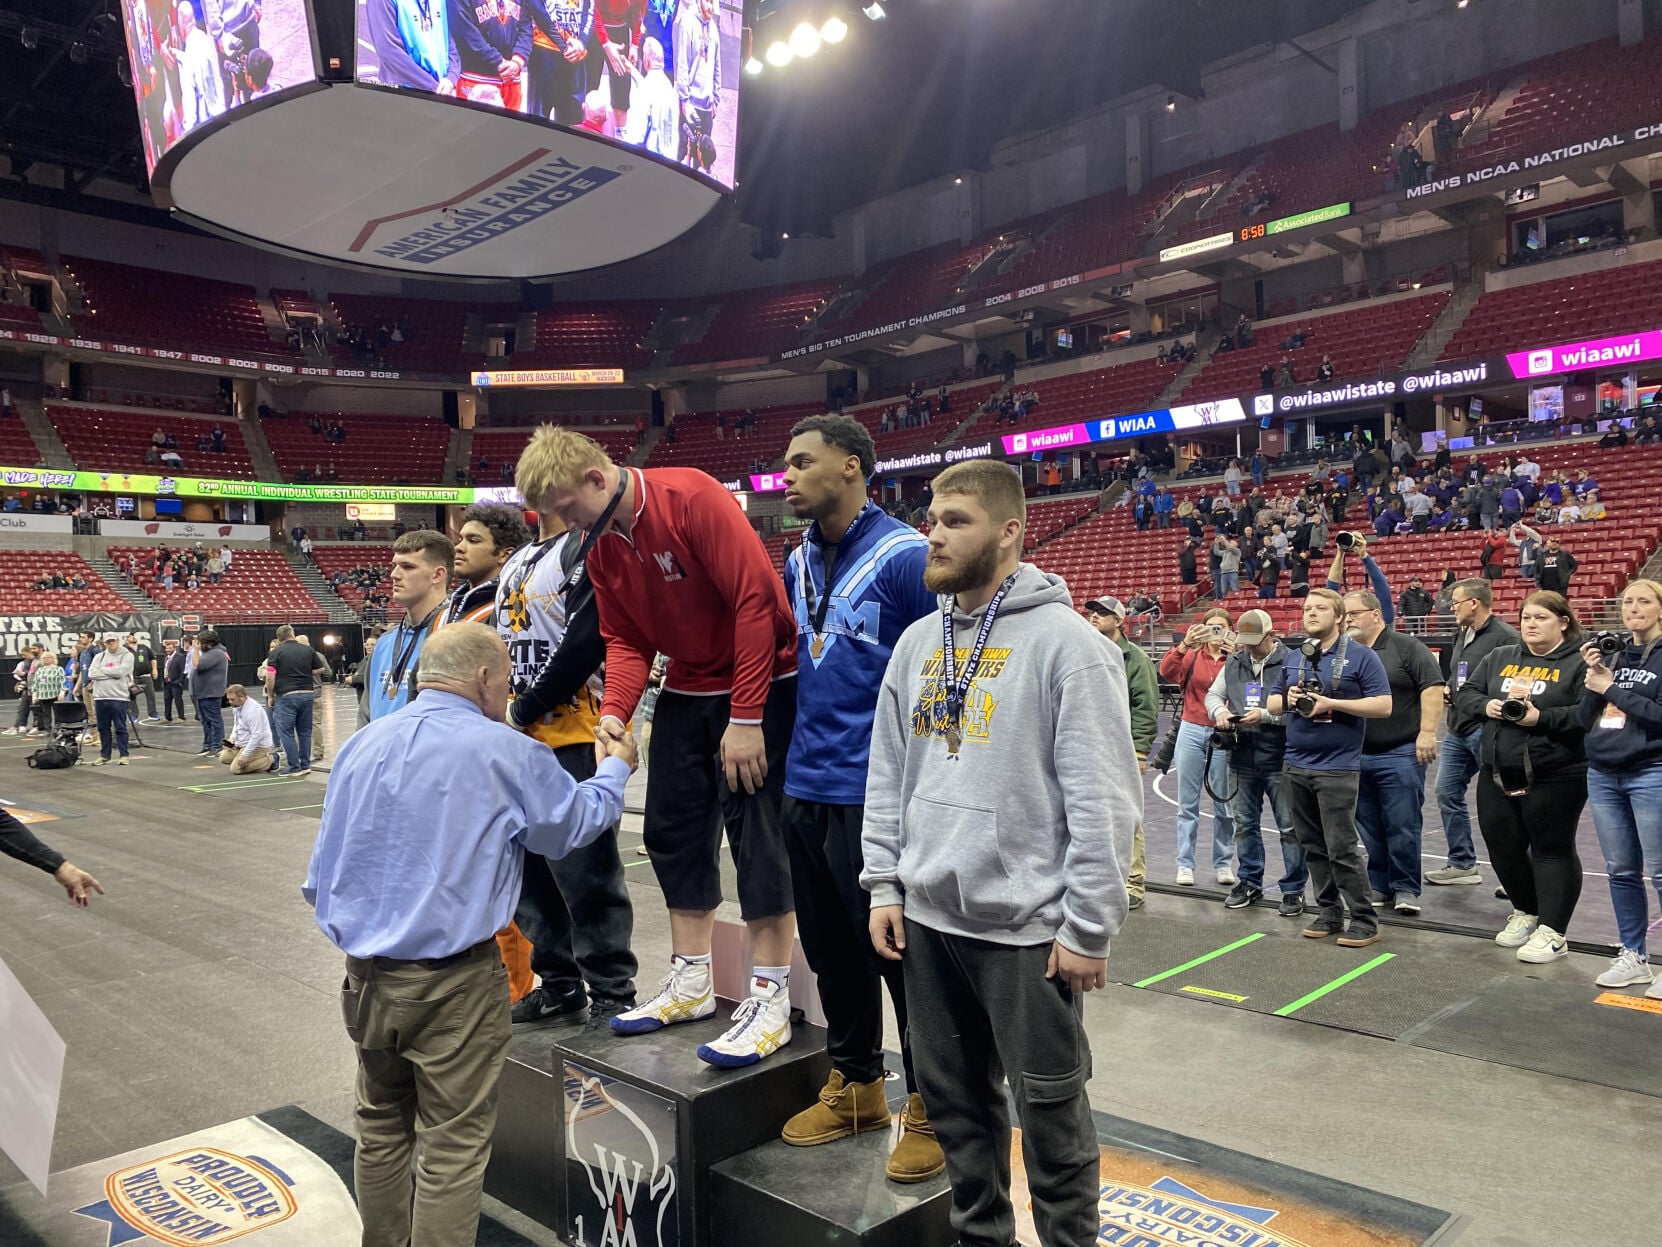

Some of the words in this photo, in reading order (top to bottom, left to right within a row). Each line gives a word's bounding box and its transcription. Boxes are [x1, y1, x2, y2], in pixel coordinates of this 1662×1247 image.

[1406, 176, 1461, 199] MEN'S
[1467, 161, 1520, 183] NCAA
[1524, 135, 1625, 168] NATIONAL
[374, 208, 491, 259] AMERICAN
[479, 157, 582, 212] FAMILY
[417, 178, 599, 258] INSURANCE
[1241, 224, 1265, 241] 8:58
[985, 293, 1012, 307] 2004
[1018, 284, 1045, 298] 2008
[1053, 275, 1080, 289] 2015
[781, 347, 806, 360] MEN'S
[809, 343, 823, 353] BIG
[825, 339, 842, 350] TEN
[844, 321, 907, 345] TOURNAMENT
[909, 305, 966, 328] CHAMPIONS
[25, 333, 58, 345] 1929
[69, 338, 102, 350] 1935
[112, 344, 142, 355] 1941
[153, 348, 183, 360] 1947
[191, 354, 221, 365] 2002
[229, 359, 258, 369] 2003
[265, 363, 293, 373] 2008
[302, 367, 329, 376] 2015
[336, 369, 365, 378] 2020
[371, 371, 399, 380] 2022
[1561, 339, 1641, 367] wiaawi
[495, 374, 516, 383] STATE
[517, 373, 534, 383] BOYS
[535, 371, 577, 382] BASKETBALL
[1280, 380, 1396, 410] @wiaawistate
[1403, 363, 1487, 391] @wiaawi
[1031, 428, 1074, 447] wiaawi
[1118, 416, 1156, 433] WIAA
[875, 452, 941, 473] @wiaawistate
[945, 443, 991, 462] @wiaawi
[222, 483, 259, 496] ANNUAL
[261, 485, 314, 498] INDIVIDUAL
[315, 487, 368, 499] WRESTLING
[370, 489, 397, 500] STATE
[398, 490, 459, 501] TOURNAMENT
[0, 616, 63, 632] TATE
[944, 615, 955, 686] CHAMPIONSHIPS
[960, 662, 976, 690] STATE
[973, 591, 1004, 662] CHAMPIONSHIPS
[1499, 664, 1560, 682] MAMA
[1500, 677, 1547, 695] BD
[1613, 667, 1658, 685] PPORT
[172, 1153, 281, 1218] PROUDLY
[173, 1175, 228, 1210] DAIRY
[122, 1168, 232, 1240] WISCONSIN
